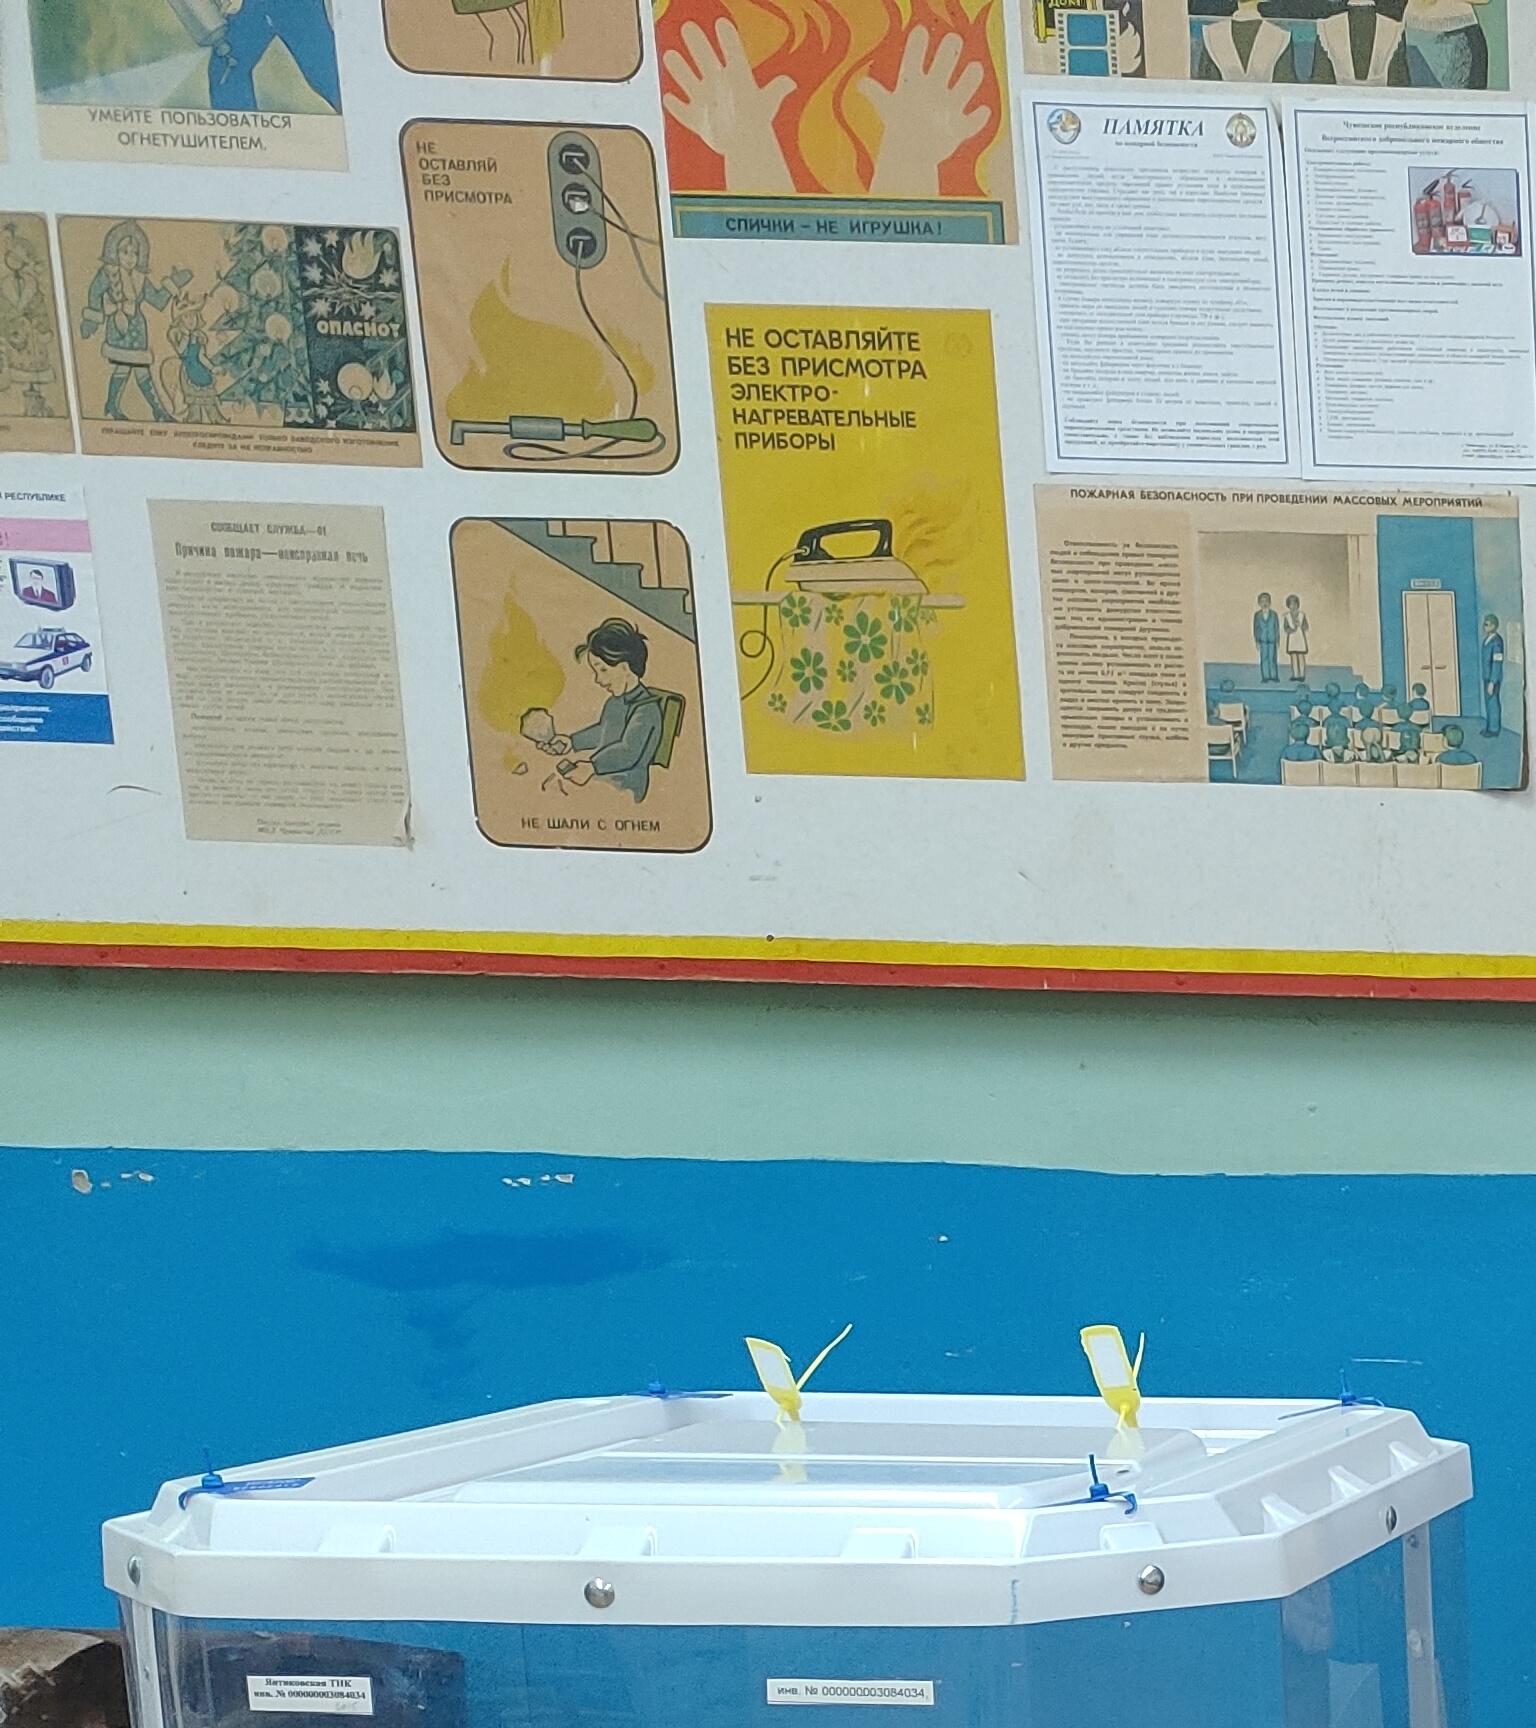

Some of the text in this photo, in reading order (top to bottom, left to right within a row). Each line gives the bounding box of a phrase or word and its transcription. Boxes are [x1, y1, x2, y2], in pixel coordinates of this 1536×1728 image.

[89, 107, 292, 131] УМЕЙТЕ ПОЛЬЗОВАТЬСЯ
[1102, 118, 1205, 137] ПАМЯТКА
[118, 131, 267, 152] ОГНЕТУШИТЕЛЕМ.
[415, 140, 436, 155] НЕ
[418, 156, 498, 174] ОСТАВЛЯЙ
[421, 173, 451, 188] БЕЗ
[424, 188, 512, 205] ПРИСМОТРА
[726, 217, 942, 236] СПИЧКИ НЕ ИГРУШКА!
[726, 326, 921, 352] НЕ ОСТАВЛЯЙТЕ
[727, 357, 927, 379] БЕЗ ПРИСМОТРА
[730, 384, 838, 402] ЭЛЕКТРО-
[732, 408, 917, 428] НАГРЕВАТЕЛЬНЫЕ
[735, 432, 836, 450] ПРИБОРЫ
[4, 492, 66, 502] РЕСПУБЛИКЕ
[1070, 488, 1483, 508] ПОЖАРНАЯ БЕЗОПАСНОСТЬ ПРИ ПРОВЕДЕНИИ МАССОВЫХ МЕРОПРИЯТИЙ
[175, 541, 217, 558] Причина
[521, 817, 660, 832] НЕ ШАЛИ С ОГНЕМ
[330, 1679, 352, 1688] ТИК
[805, 1686, 818, 1696] №
